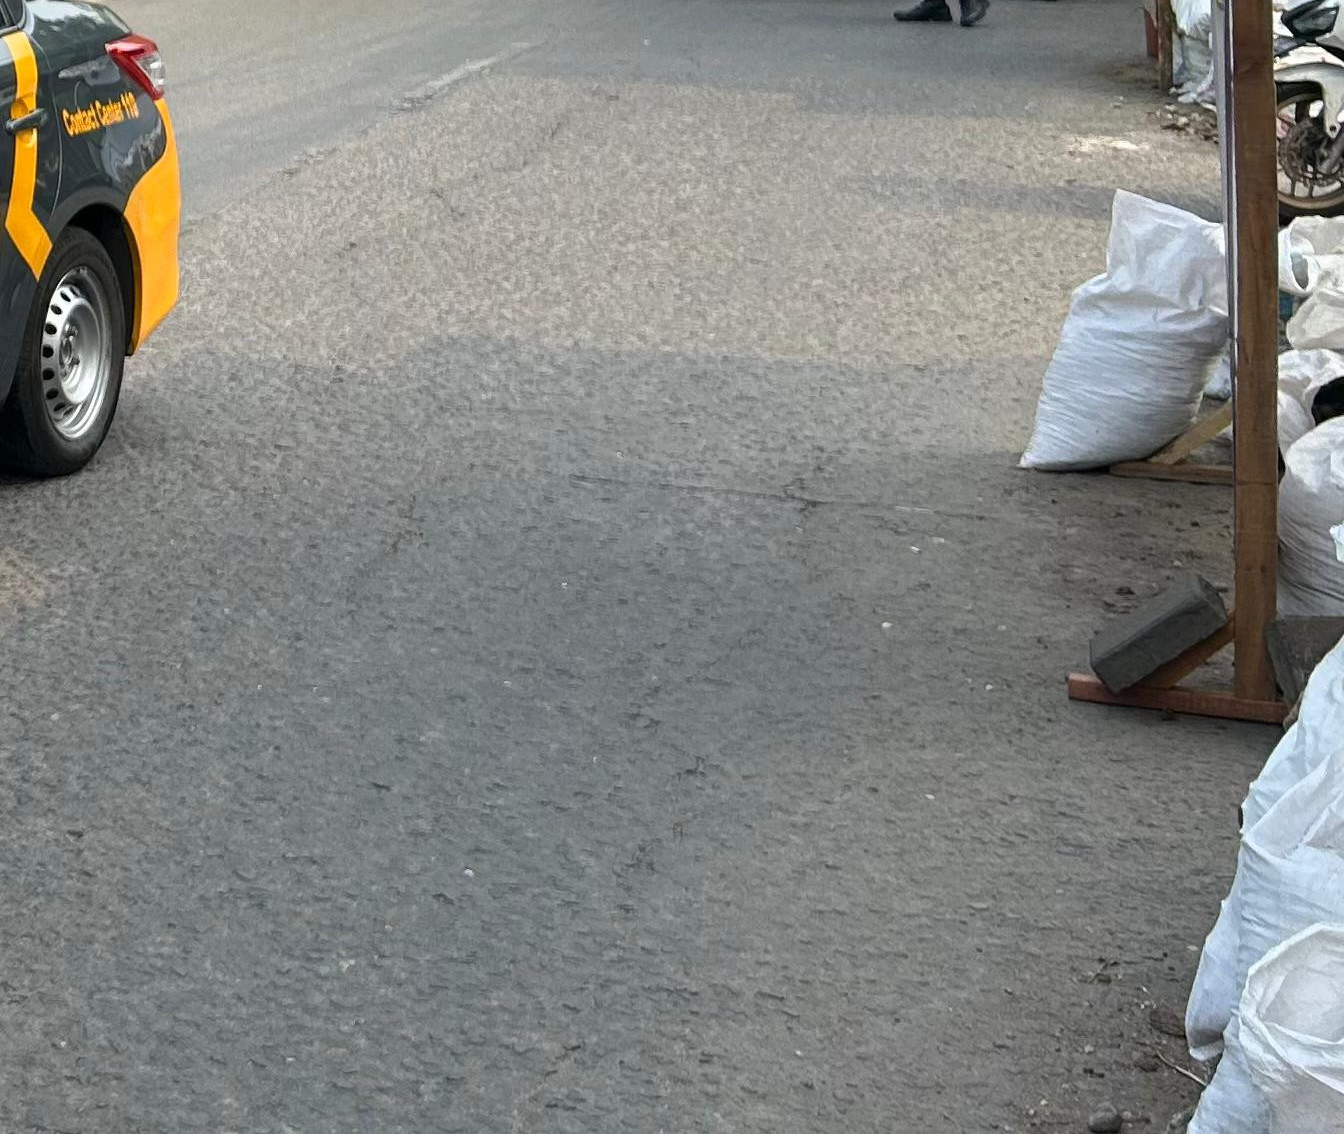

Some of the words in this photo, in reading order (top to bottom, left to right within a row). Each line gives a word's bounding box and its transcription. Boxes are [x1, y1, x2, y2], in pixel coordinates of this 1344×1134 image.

[62, 102, 100, 137] Contact
[95, 98, 125, 127] Center
[120, 90, 140, 120] 110
